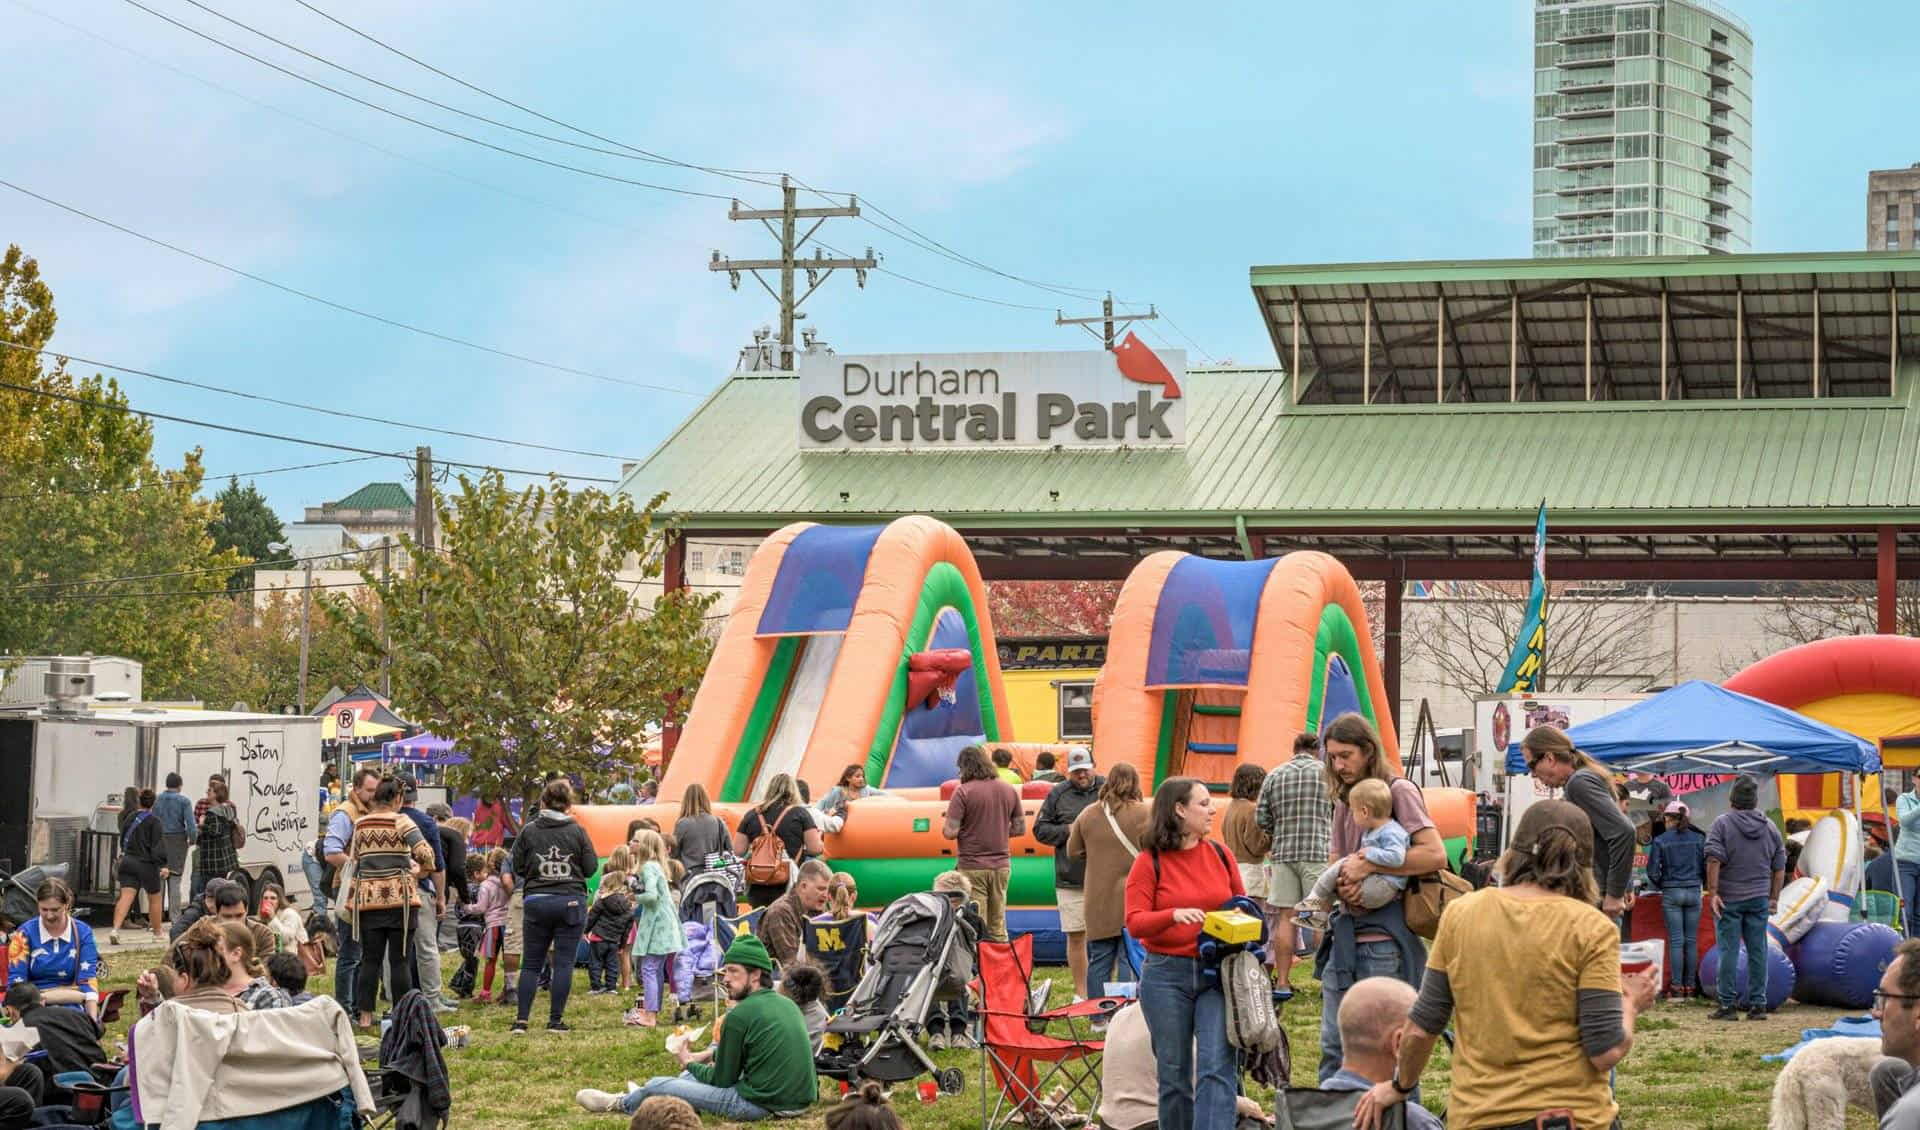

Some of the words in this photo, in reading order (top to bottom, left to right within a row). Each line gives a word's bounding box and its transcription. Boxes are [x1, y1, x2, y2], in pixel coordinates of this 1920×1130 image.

[843, 361, 1000, 396] Durham
[801, 391, 1017, 443] Central
[1037, 390, 1173, 440] Park
[237, 736, 279, 760] Baton
[242, 770, 295, 806] Rouge
[255, 806, 308, 833] Cuisine
[816, 928, 846, 952] M
